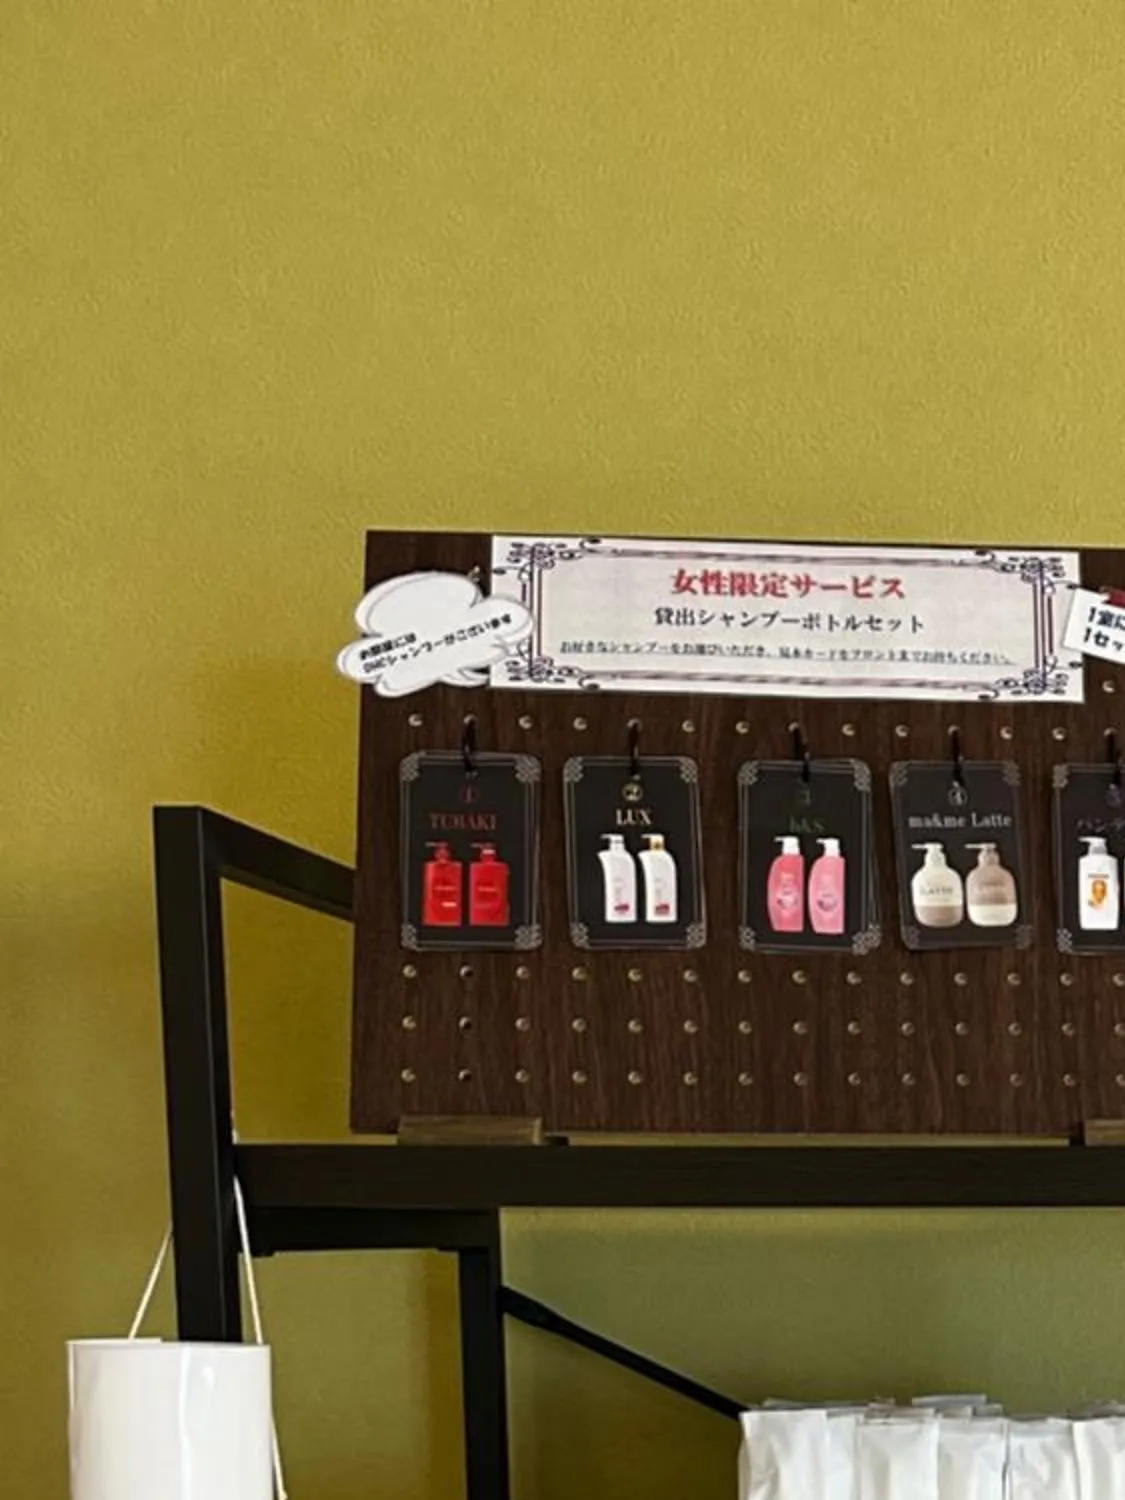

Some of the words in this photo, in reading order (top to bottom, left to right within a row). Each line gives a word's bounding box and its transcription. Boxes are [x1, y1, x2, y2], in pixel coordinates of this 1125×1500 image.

[671, 567, 906, 599] 女性限定サービス
[655, 605, 924, 634] 貸出シャンプーボトルセット
[615, 809, 652, 826] LUX
